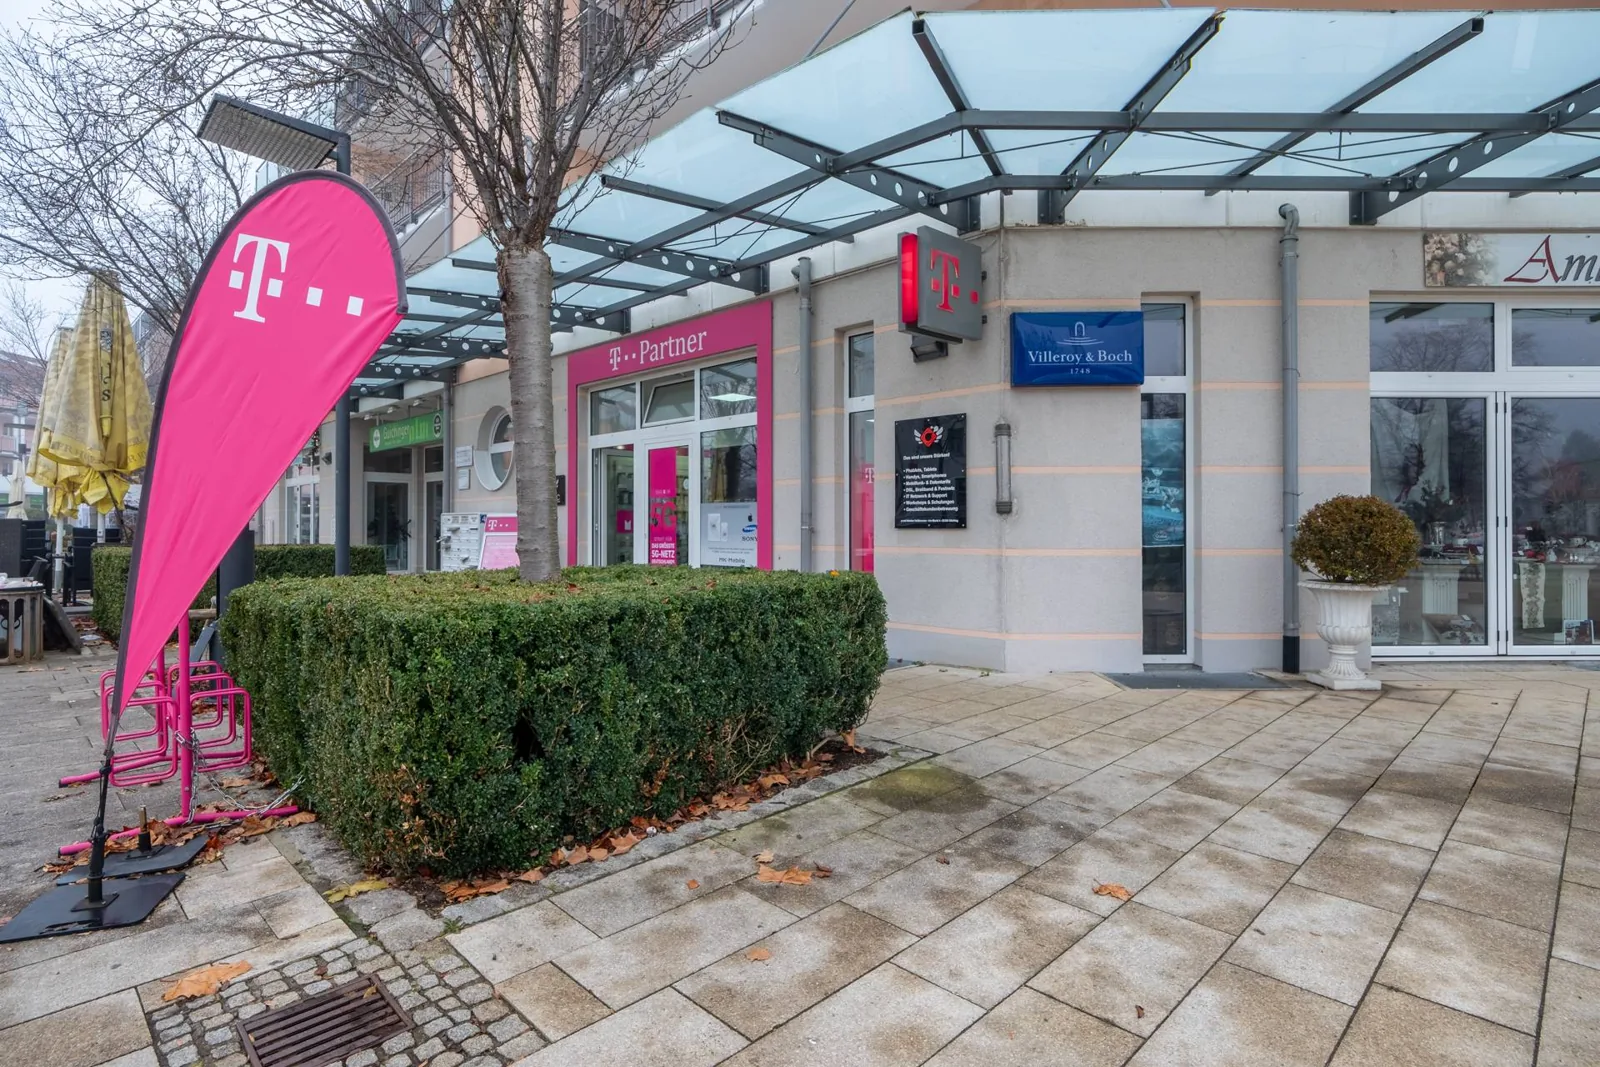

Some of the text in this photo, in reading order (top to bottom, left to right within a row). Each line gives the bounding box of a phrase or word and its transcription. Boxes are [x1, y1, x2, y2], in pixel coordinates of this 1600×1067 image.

[1503, 234, 1600, 284] Am
[639, 331, 708, 364] Partner
[1028, 350, 1132, 364] Villeroy & Boch
[652, 549, 675, 559] 5G-NETZ
